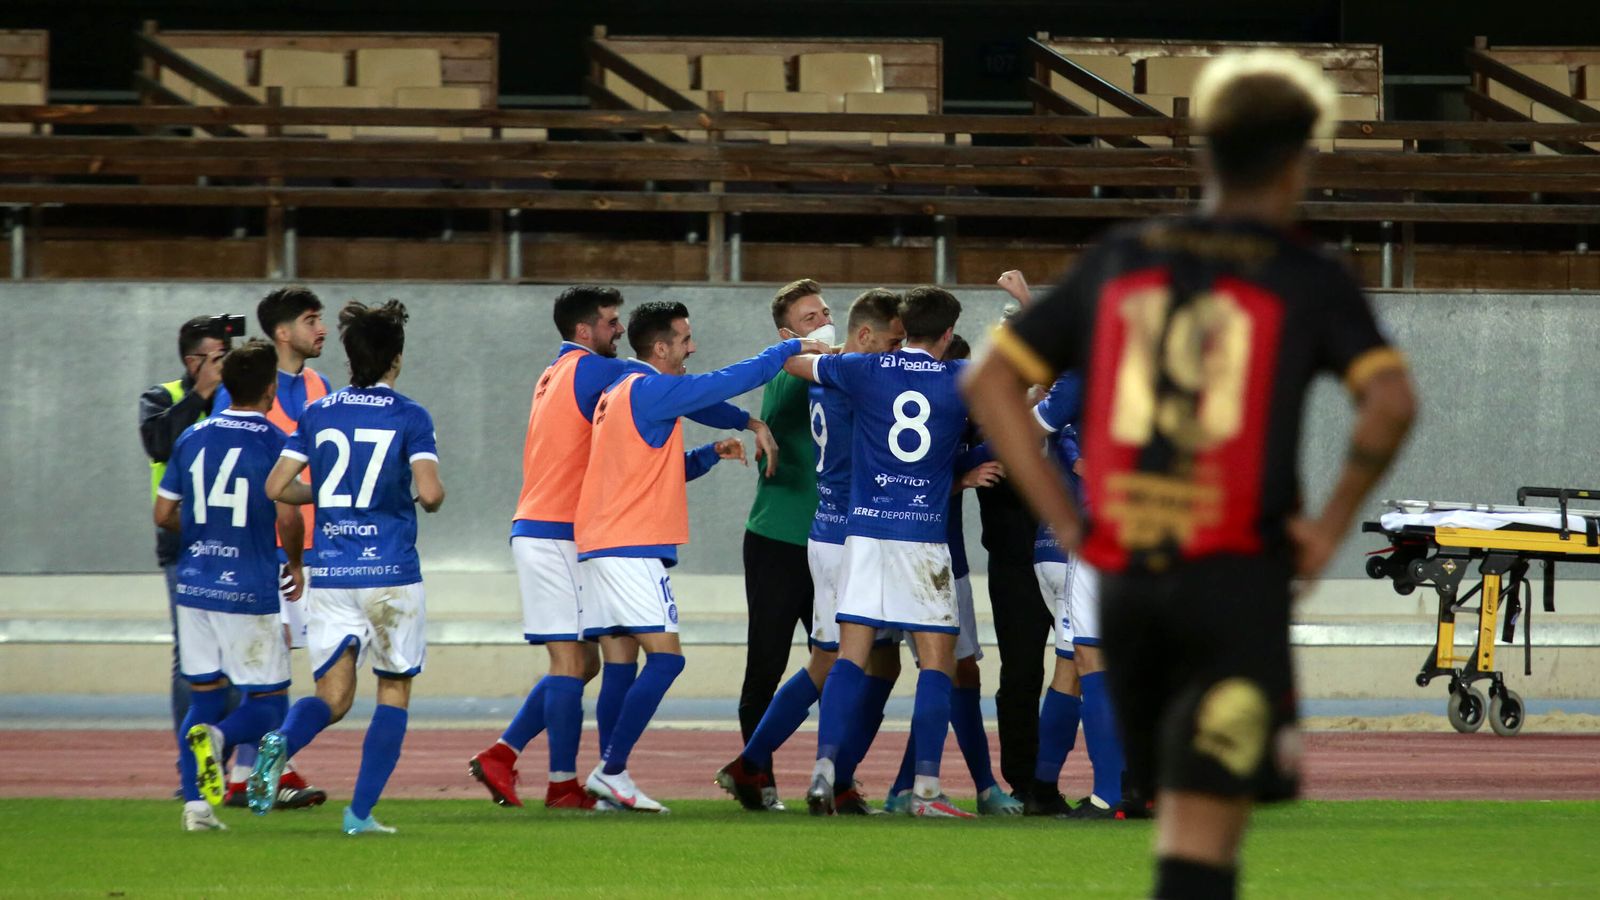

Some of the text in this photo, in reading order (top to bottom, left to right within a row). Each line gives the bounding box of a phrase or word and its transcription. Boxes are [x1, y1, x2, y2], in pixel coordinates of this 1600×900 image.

[984, 54, 1016, 72] 107
[1110, 285, 1252, 447] 19
[809, 400, 828, 473] 9
[888, 390, 931, 463] 8
[188, 446, 249, 527] 14
[315, 428, 396, 508] 27
[853, 506, 880, 518] XEREZ
[881, 510, 928, 522] DEPORTIVO
[186, 585, 240, 602] DEPORTIVO
[330, 565, 384, 577] DEPORTIVO
